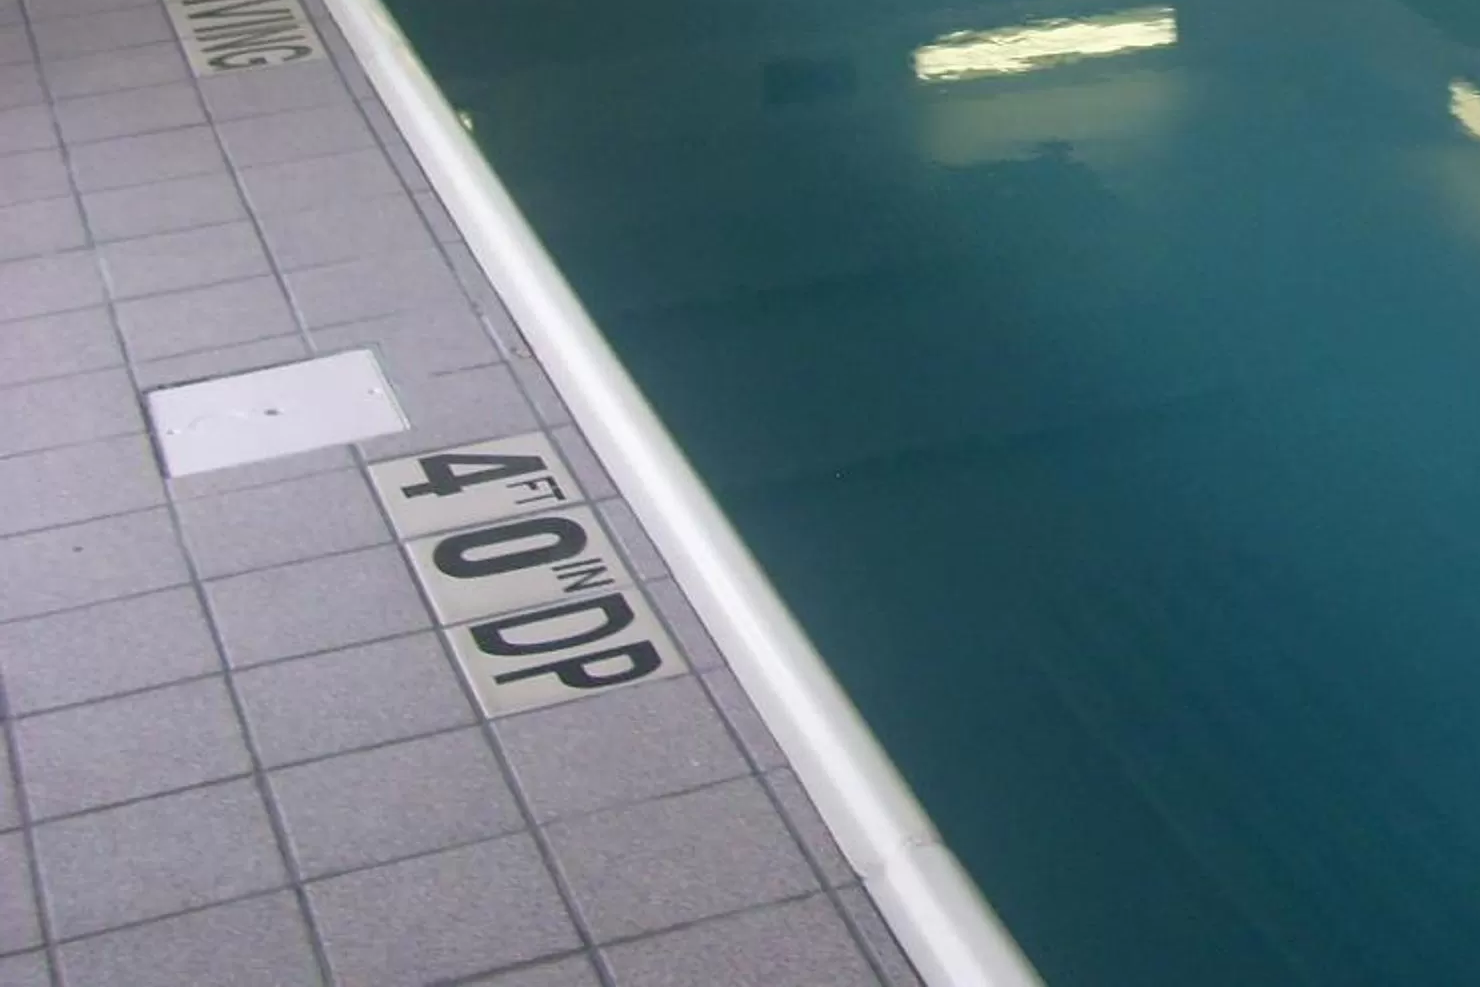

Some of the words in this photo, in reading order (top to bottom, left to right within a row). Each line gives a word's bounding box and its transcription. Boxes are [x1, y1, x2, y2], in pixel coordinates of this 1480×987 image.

[402, 452, 547, 499] 4
[507, 475, 566, 505] FT
[553, 557, 614, 593] IN
[470, 592, 662, 689] DP
